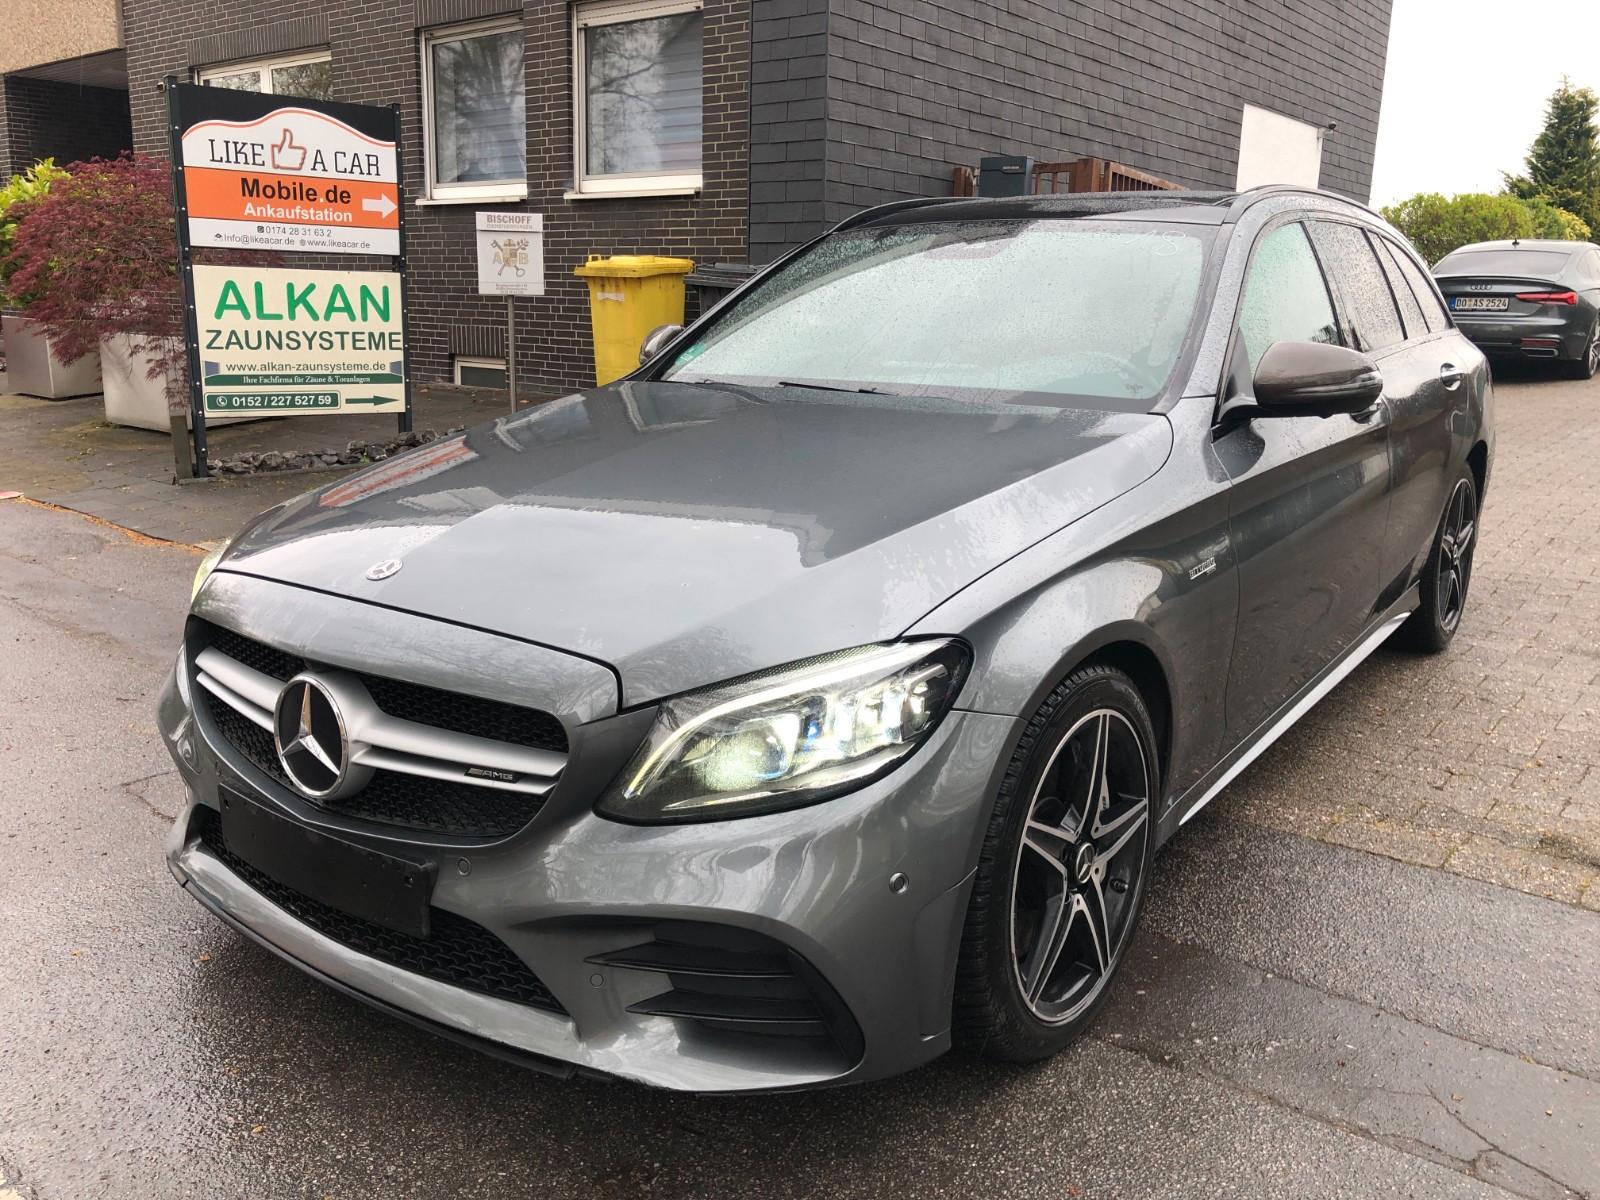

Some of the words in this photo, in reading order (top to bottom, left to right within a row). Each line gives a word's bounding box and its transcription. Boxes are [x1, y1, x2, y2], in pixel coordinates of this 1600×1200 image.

[208, 139, 265, 167] LIKE
[310, 149, 328, 172] A
[334, 151, 381, 176] CAR
[240, 177, 351, 204] Mobile.de
[243, 202, 352, 222] Ankaufstation
[486, 214, 532, 224] BISCHOFF
[265, 226, 287, 235] 0174
[289, 228, 299, 236] 28
[302, 228, 312, 236] 31
[314, 229, 325, 237] 63
[307, 240, 370, 249] www.likeacar.de
[214, 280, 391, 323] ALKAN
[1456, 298, 1467, 308] DO
[1473, 298, 1484, 308] AS
[1485, 298, 1507, 308] 2524
[205, 329, 403, 351] ZAUNSYSTEME
[225, 361, 386, 374] www.alkan-zaunsysteme.de
[243, 376, 258, 384] Ihre
[259, 376, 293, 384] Fachfirma
[294, 376, 304, 384] für
[305, 376, 326, 384] Zäune
[334, 376, 371, 385] Toranlagen
[232, 396, 262, 407] 0152
[263, 396, 268, 406] /
[270, 396, 292, 406] 227
[294, 395, 315, 405] 527
[317, 395, 332, 405] 59
[481, 770, 513, 781] AMG
